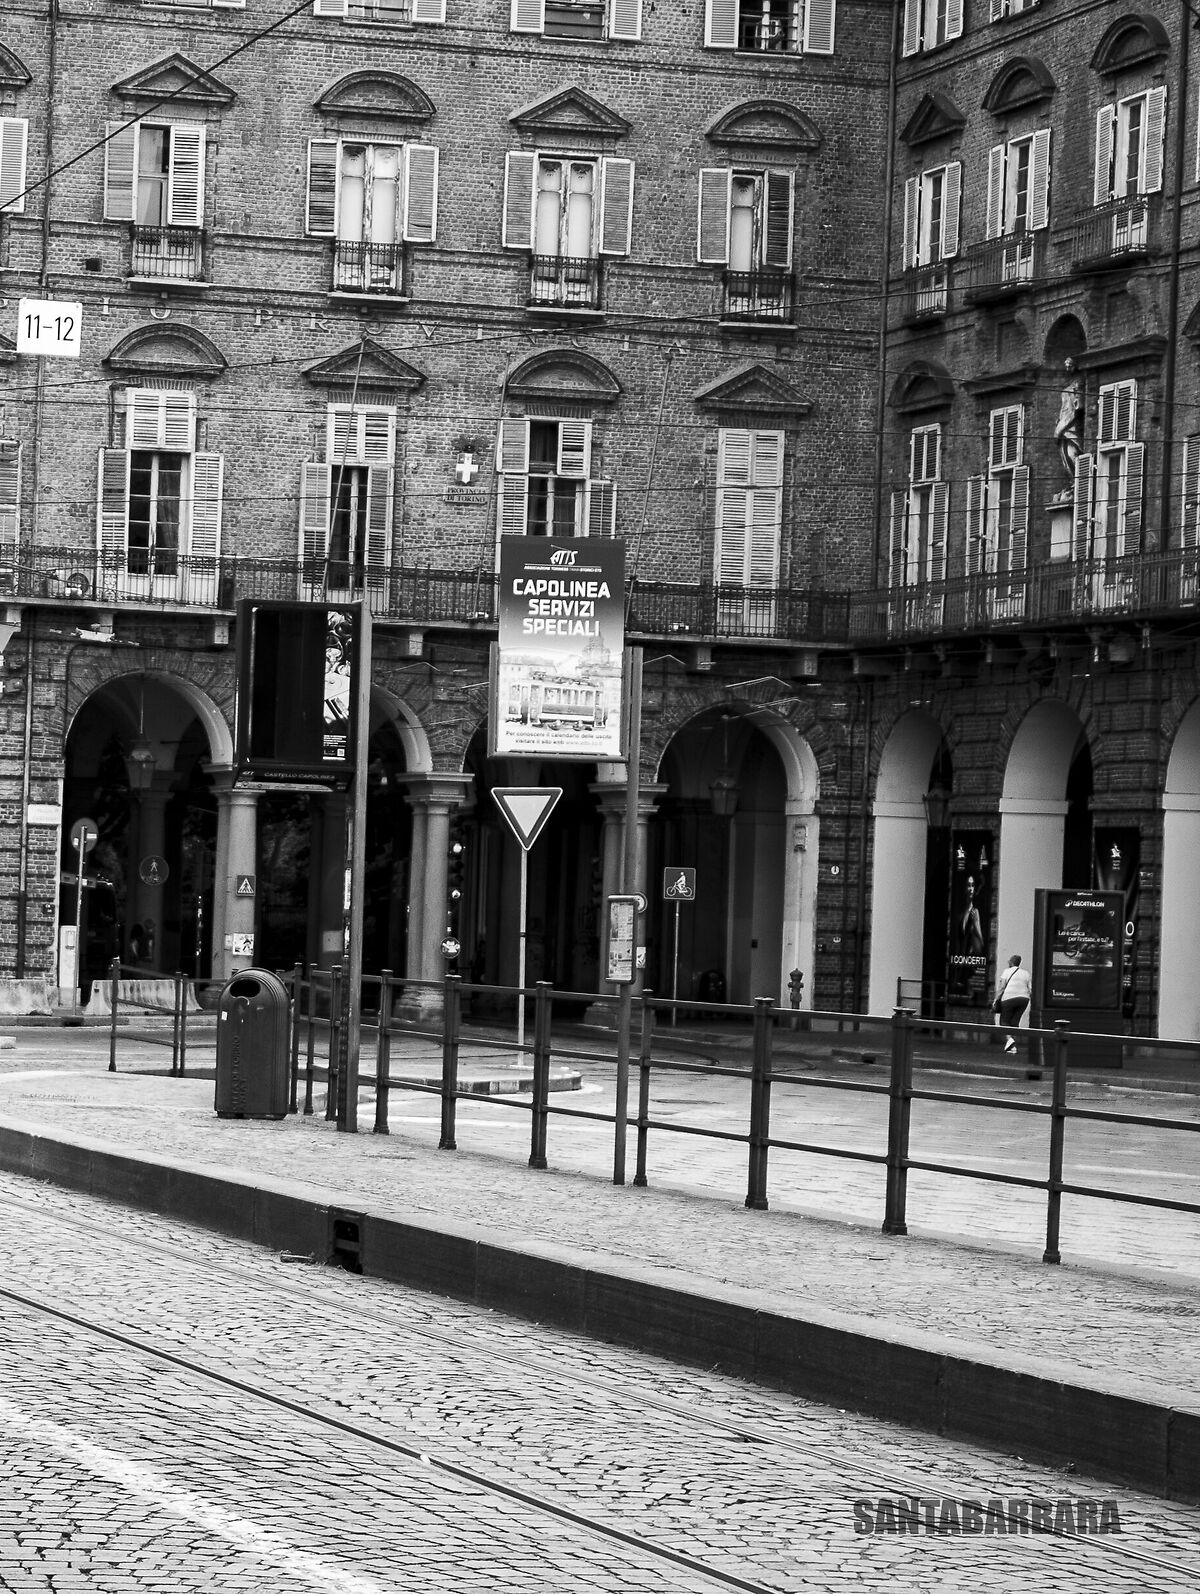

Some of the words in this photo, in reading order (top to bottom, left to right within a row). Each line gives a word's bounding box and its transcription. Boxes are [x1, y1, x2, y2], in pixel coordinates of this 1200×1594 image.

[25, 314, 75, 342] 11-12
[513, 579, 611, 598] CAPOLINEA
[528, 598, 595, 617] SERVIZI
[522, 617, 600, 637] SPECIALI
[954, 955, 987, 966] CONCERTI
